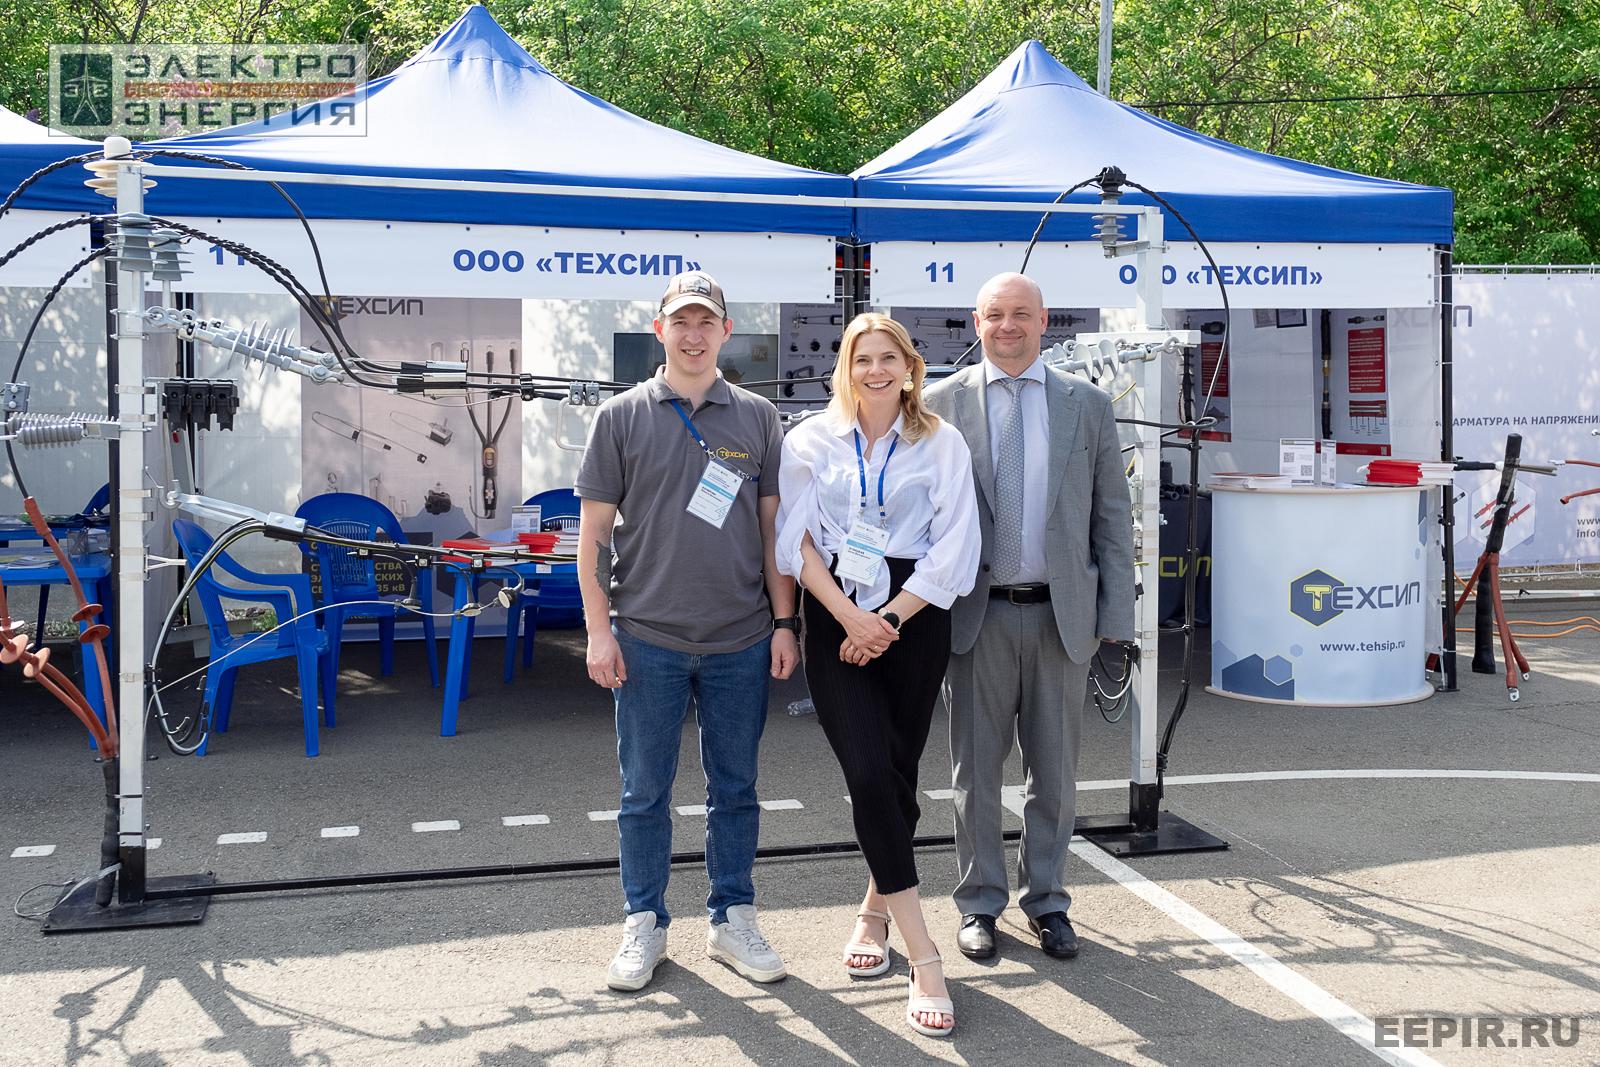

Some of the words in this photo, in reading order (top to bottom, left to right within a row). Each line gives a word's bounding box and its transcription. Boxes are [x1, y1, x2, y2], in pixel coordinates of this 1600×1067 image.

[453, 249, 525, 273] ООО
[536, 252, 702, 276] «ТЕХСИП»
[925, 261, 954, 283] 11
[1119, 264, 1177, 285] ОО
[1186, 265, 1323, 286] «ТЕХСИП»
[1452, 416, 1510, 427] АРМАТУРА
[1513, 416, 1528, 425] НА
[1531, 415, 1600, 425] НАПРЯЖЕНИ
[1576, 529, 1600, 538] info
[1303, 581, 1420, 612] ТЕХСИП
[1319, 640, 1406, 653] www.tehsip.ru
